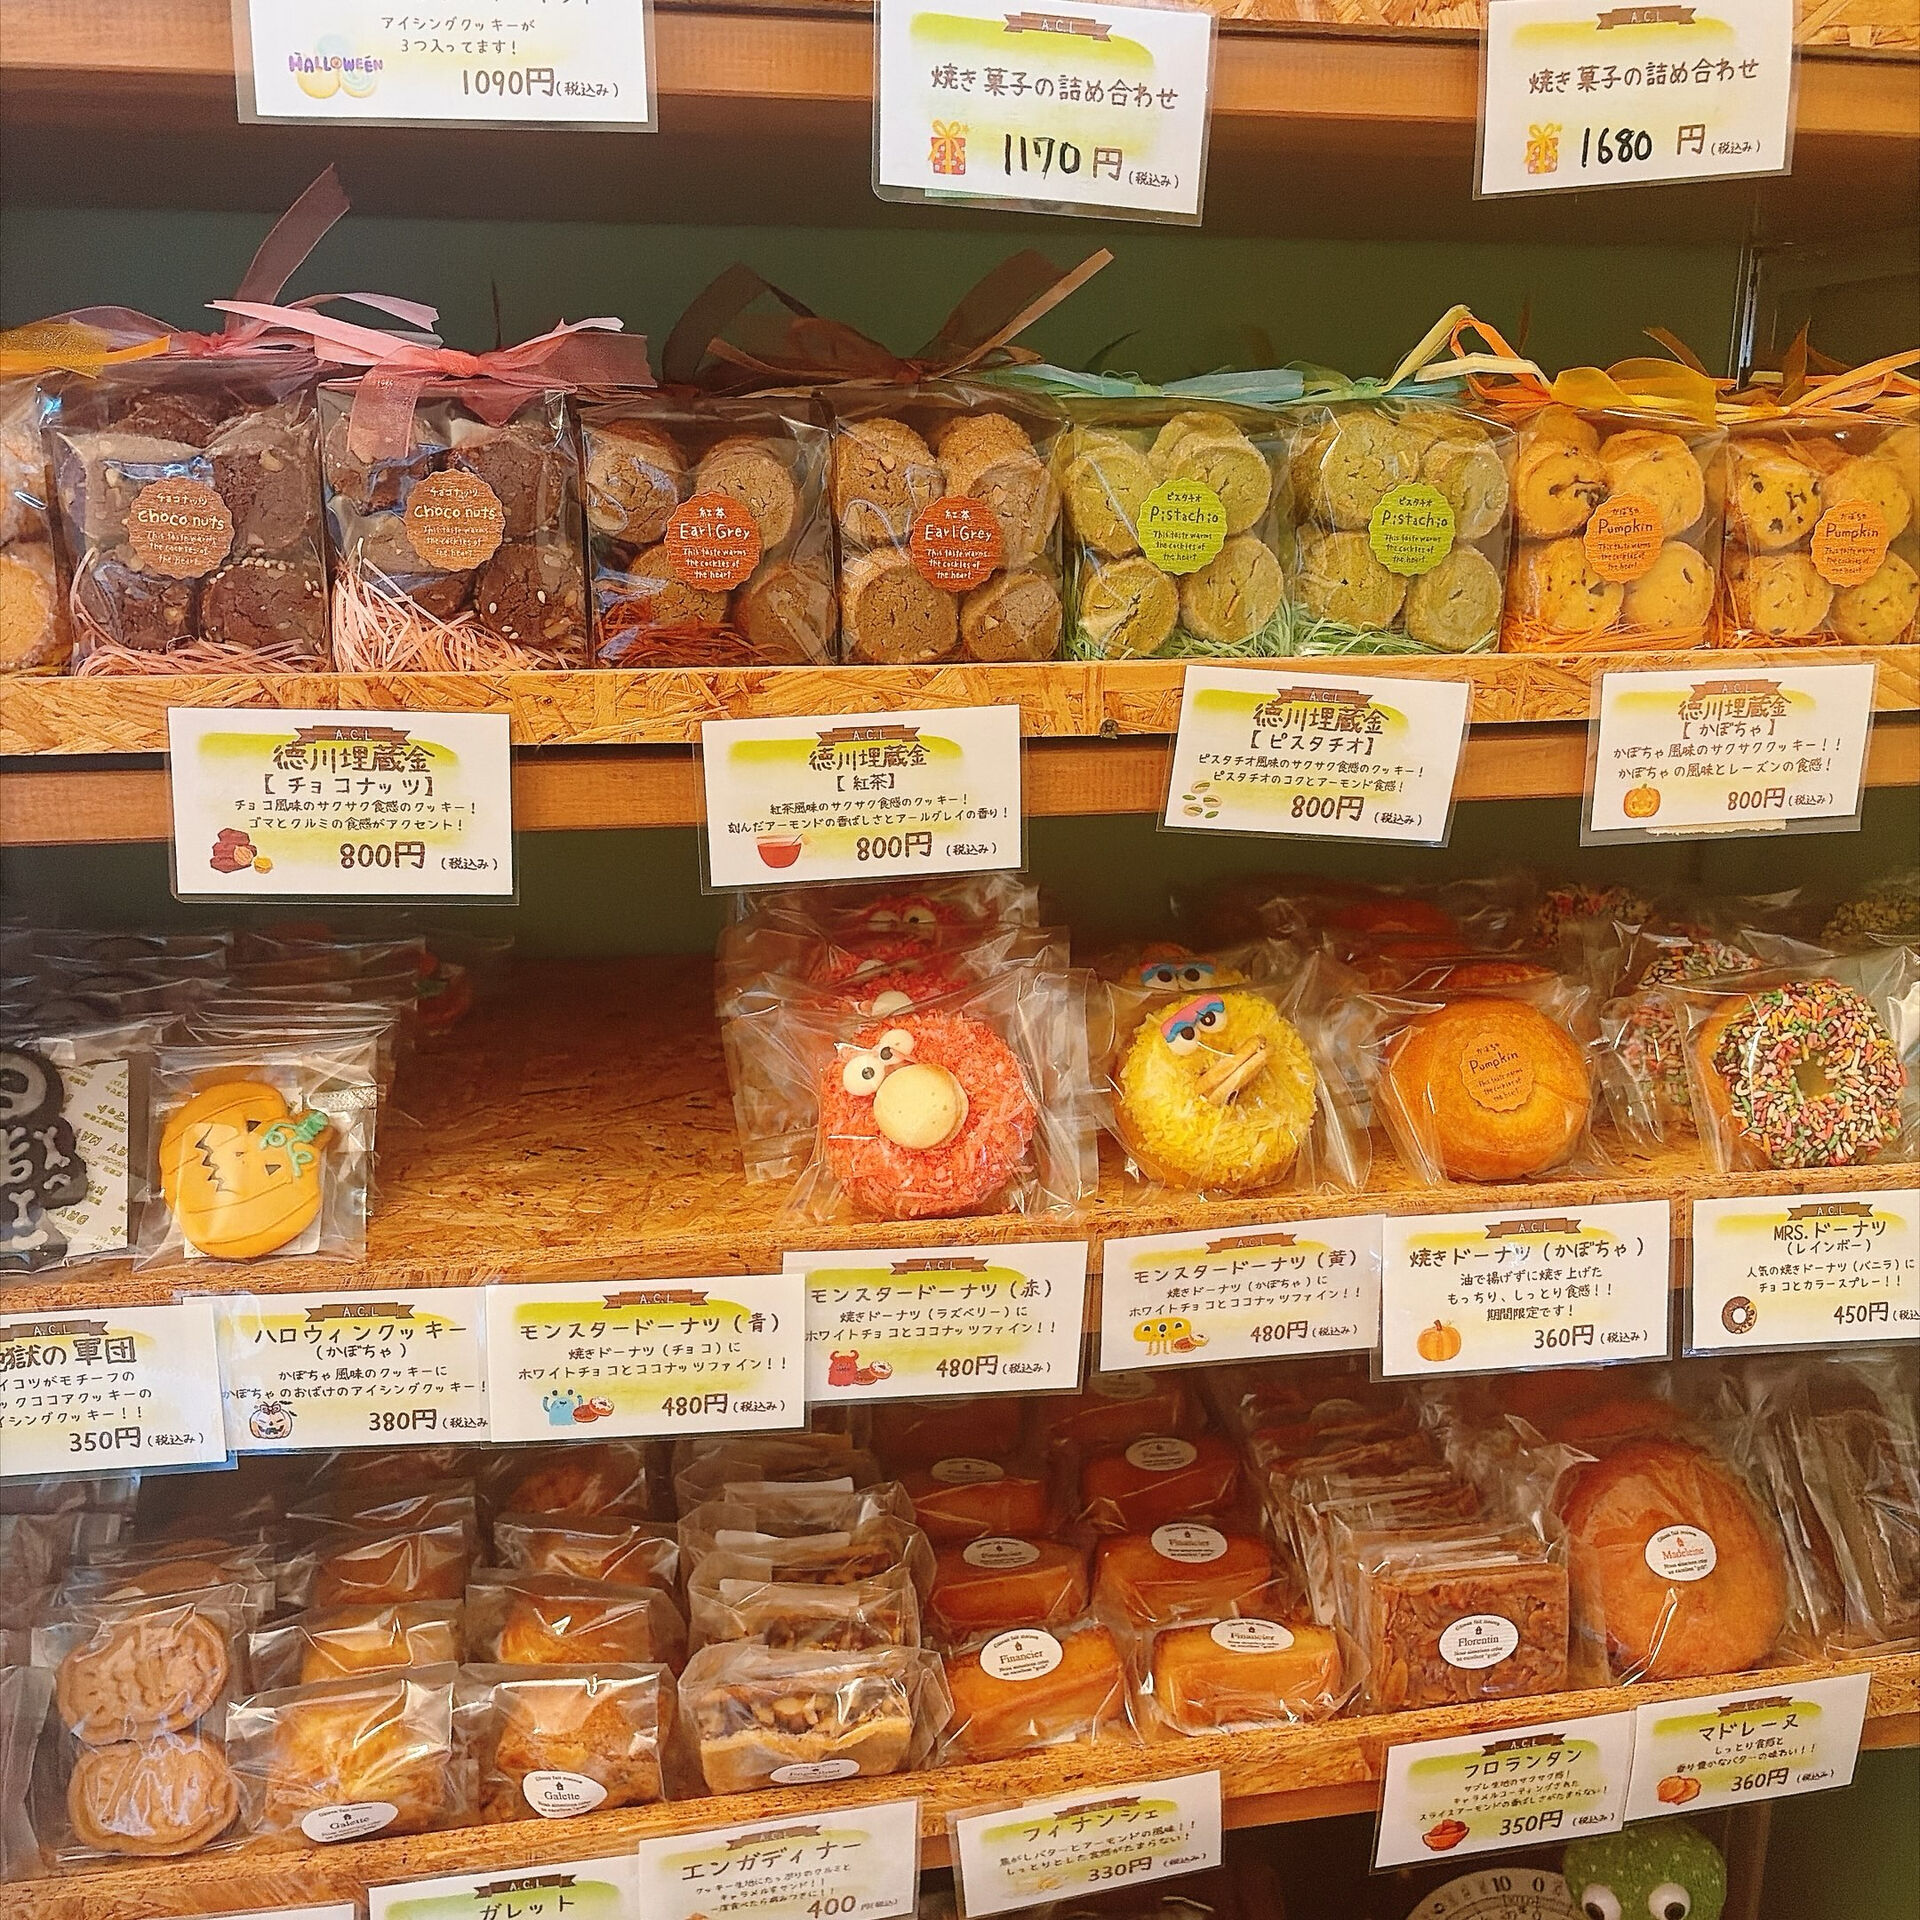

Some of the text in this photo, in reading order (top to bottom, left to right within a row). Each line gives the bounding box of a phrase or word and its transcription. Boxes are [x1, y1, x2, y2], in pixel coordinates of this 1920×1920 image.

[380, 16, 536, 32] アイシングクッキーが
[288, 54, 383, 74] HALLOWEEN
[1529, 58, 1759, 94] 焼き菓子の詰め合わせ
[463, 68, 554, 97] 1090円
[931, 62, 1178, 110] 焼き菓子の詰め合わせ
[1004, 134, 1081, 179] 1170
[1093, 146, 1124, 181] 円
[1581, 127, 1652, 168] 1680
[1676, 123, 1706, 156] 円
[1167, 492, 1202, 502] ピスタチオ
[193, 516, 225, 530] nuts
[465, 507, 496, 520] nuts
[699, 507, 726, 519] 紅茶
[945, 509, 971, 520] 紅茶
[1150, 506, 1219, 523] Pistachio
[1382, 510, 1448, 527] Pistachio
[680, 523, 750, 539] Earl Grey
[925, 524, 991, 541] Earl Grey
[1598, 518, 1653, 536] Pumpkin
[1826, 523, 1878, 542] Pumpkin
[1252, 702, 1390, 736] 徳川埋蔵金
[1678, 695, 1792, 721] 徳川埋蔵金
[273, 742, 435, 773] 徳川埋蔵金
[808, 744, 931, 771] 徳川埋蔵金
[235, 799, 476, 814] チョコ風味のサクサク食感のクッキー！
[770, 794, 969, 815] 紅茶風味のサクサク食感のクッキー！
[1291, 794, 1364, 821] 800円
[1727, 787, 1786, 811] 800円
[249, 817, 463, 831] ゴマとクルミの食感がアクセント！
[340, 841, 426, 869] 800円
[856, 832, 933, 861] 800円
[1469, 1052, 1518, 1074] Pumpkin
[1409, 1237, 1645, 1269] 焼きドーナツ（かぼちゃ）
[1134, 1249, 1358, 1285] モンスタードーナツ（黄）
[1460, 1267, 1603, 1287] 油で揚げずに焼き上げた
[811, 1279, 1053, 1304] モンスタードーナツ（赤）
[1487, 1305, 1574, 1322] 期間限定です！
[1833, 1302, 1889, 1325] 450円
[254, 1320, 467, 1344] ハロウィンクッキー
[520, 1312, 781, 1340] モンスタードーナツ（青）
[1250, 1320, 1308, 1344] 480円
[1533, 1324, 1593, 1350] 360円
[279, 1365, 447, 1381] かぼちゃ風味のクッキーに
[936, 1354, 998, 1378] 480円
[661, 1392, 729, 1417] 480円
[368, 1408, 437, 1431] 380円
[69, 1427, 141, 1452] 350円
[1458, 1635, 1499, 1647] Florentin
[1000, 1650, 1043, 1664] Financier
[1699, 1713, 1799, 1742] マドレーヌ
[1465, 1749, 1583, 1779] フロランタン
[1731, 1767, 1790, 1792] 360円
[544, 1791, 580, 1800] Galette
[1024, 1808, 1160, 1843] フィナンシェ
[1499, 1810, 1563, 1836] 350円
[681, 1840, 862, 1882] エンガディナー
[1088, 1856, 1153, 1883] 330円
[806, 1895, 856, 1919] 400
